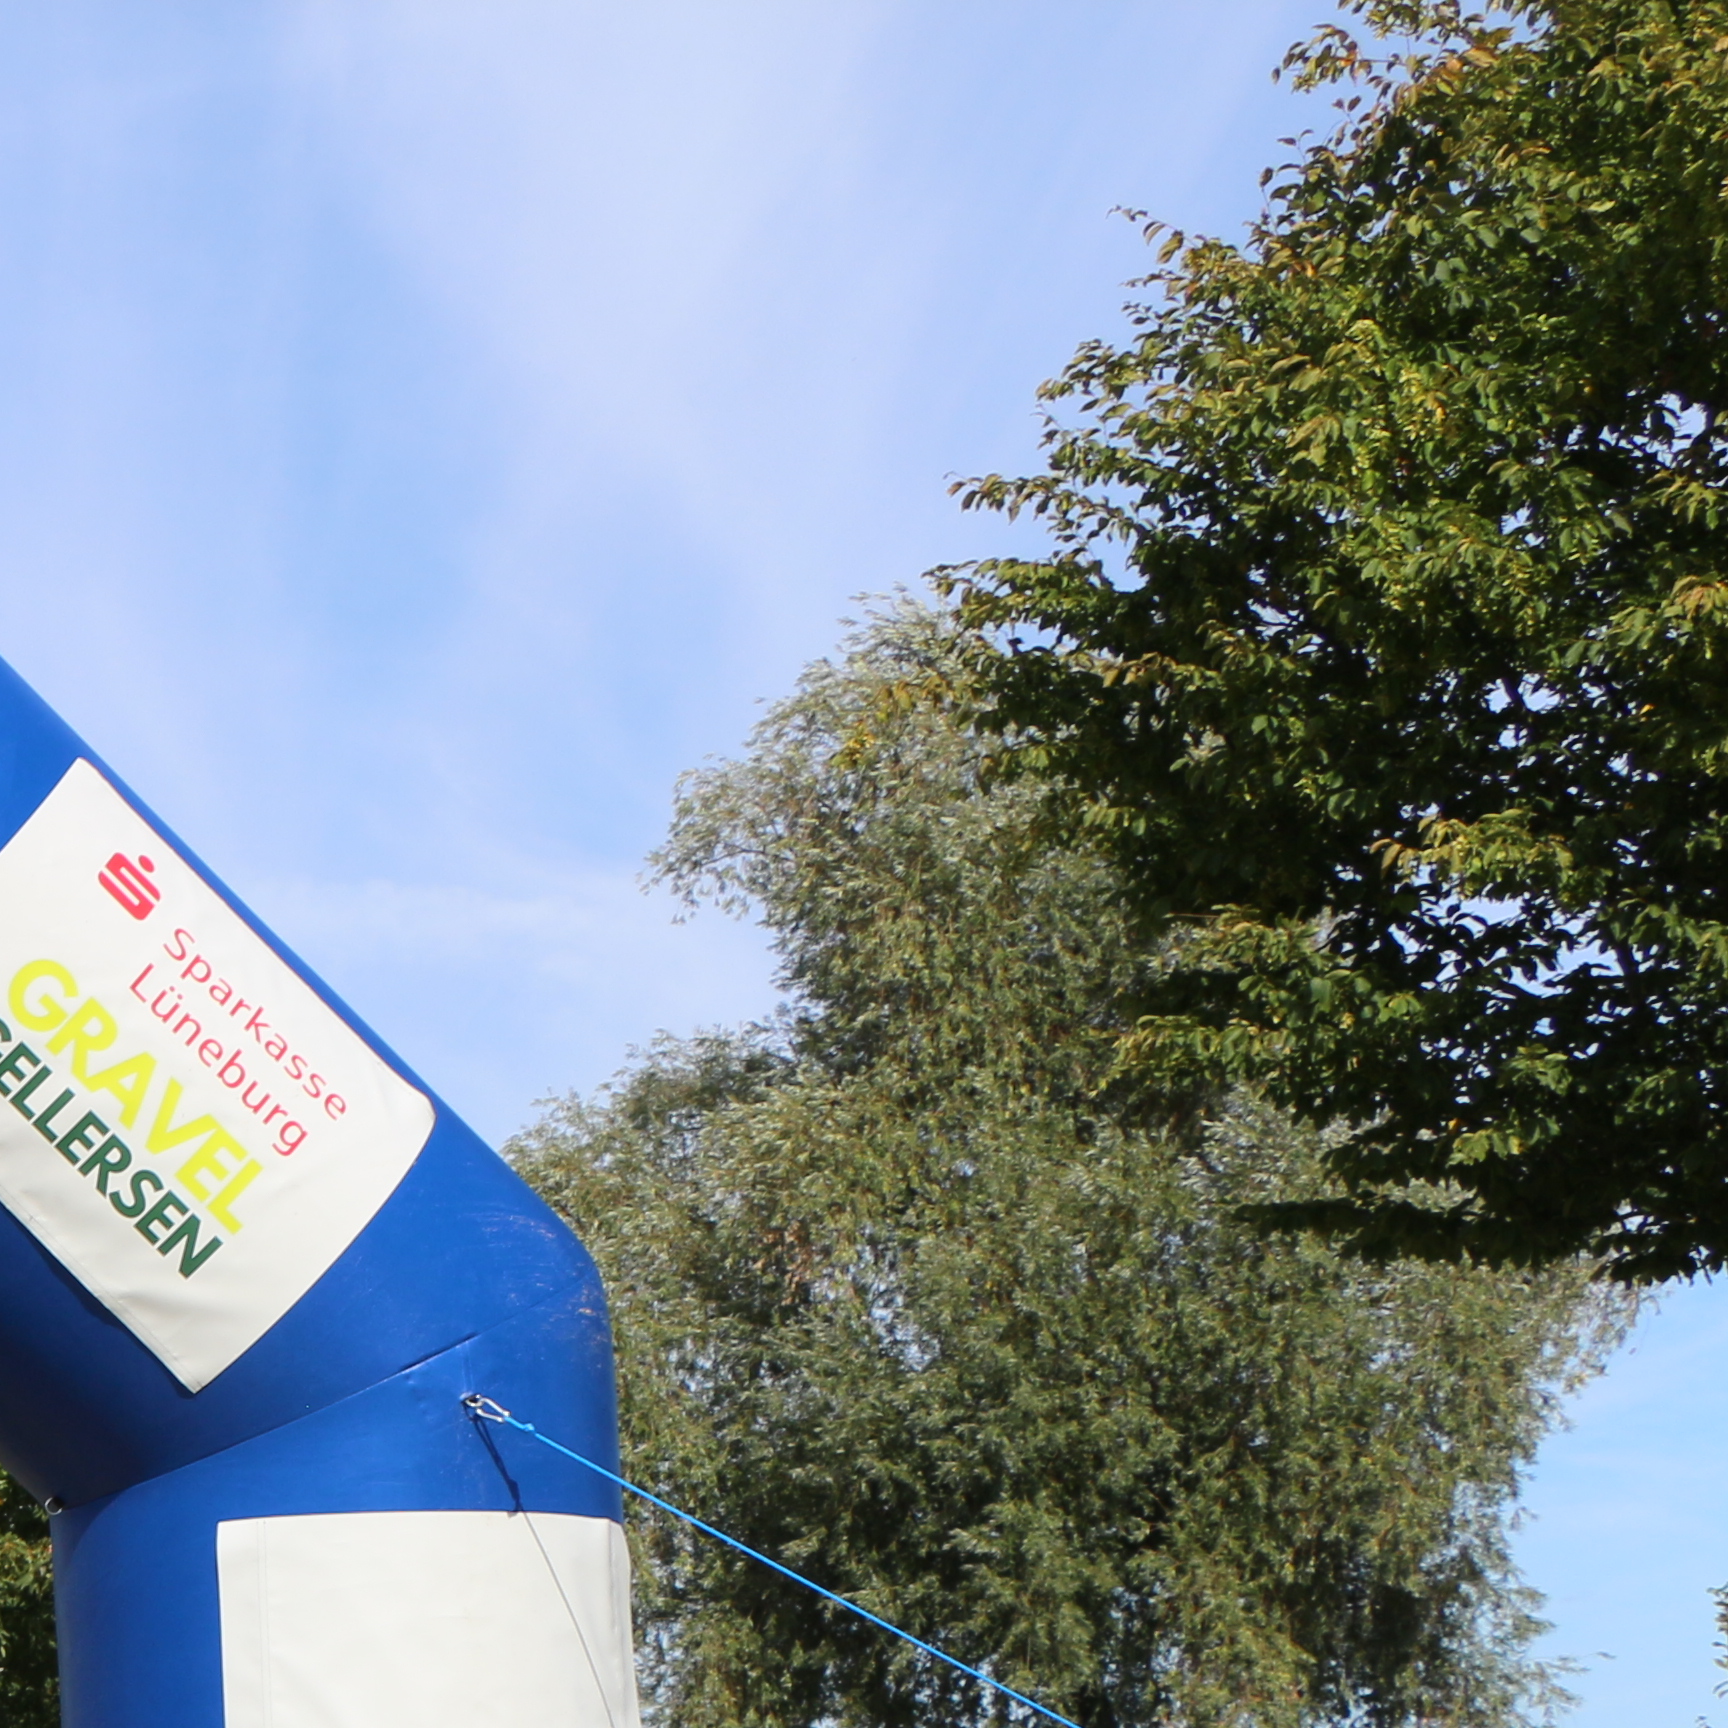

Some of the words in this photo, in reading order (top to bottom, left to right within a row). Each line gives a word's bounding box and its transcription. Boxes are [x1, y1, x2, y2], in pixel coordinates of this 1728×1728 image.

[7, 958, 264, 1235] GRAVEL
[129, 963, 309, 1157] Lüneburg
[162, 927, 348, 1122] Sparkasse
